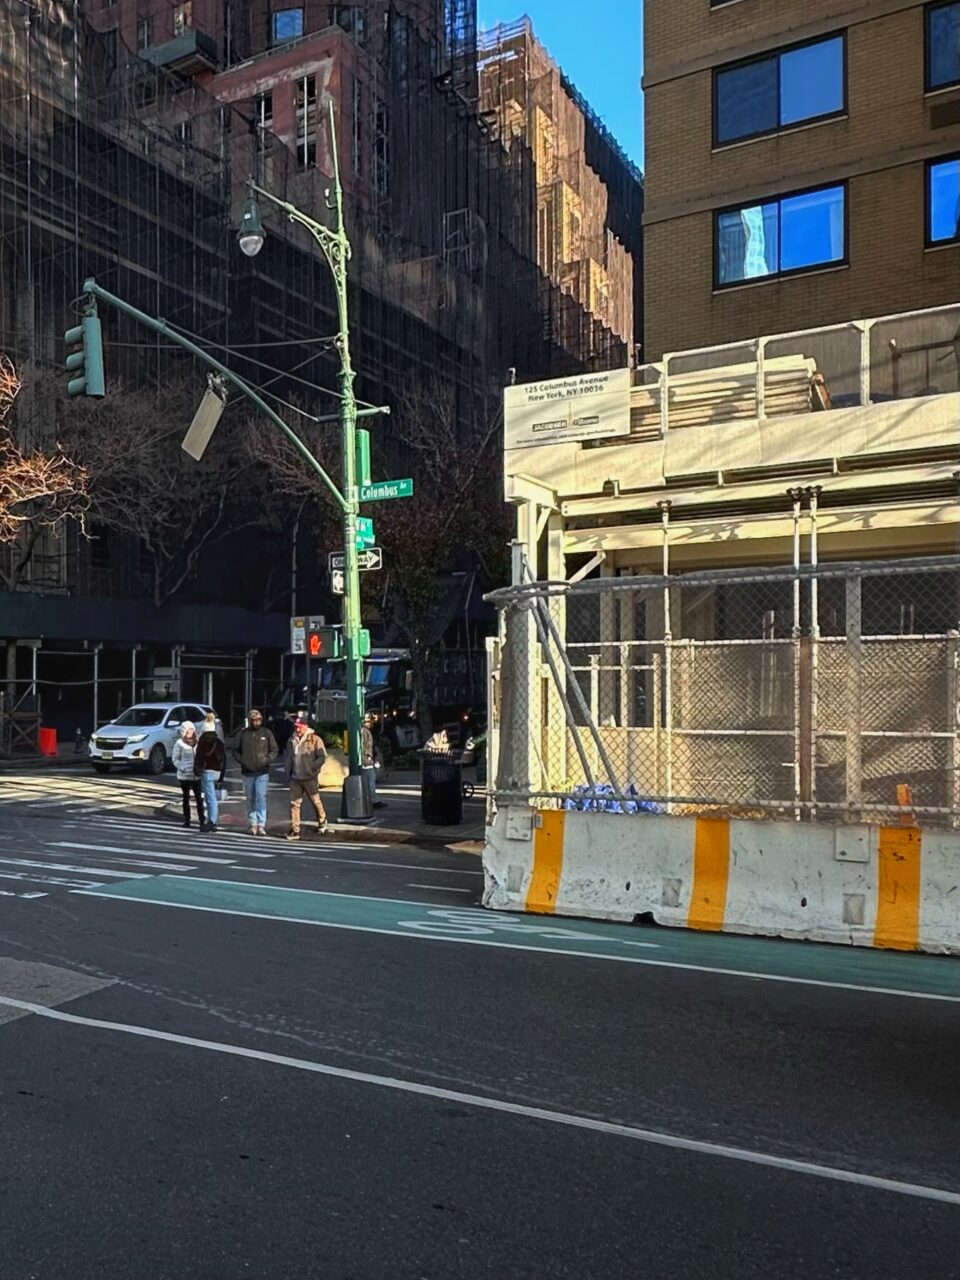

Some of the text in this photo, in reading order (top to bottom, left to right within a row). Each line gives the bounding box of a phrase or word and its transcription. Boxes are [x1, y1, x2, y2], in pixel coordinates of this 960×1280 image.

[524, 375, 609, 394] 125 Columbus Avenue
[528, 394, 545, 402] New
[566, 388, 578, 396] NY
[361, 484, 398, 499] Columbus
